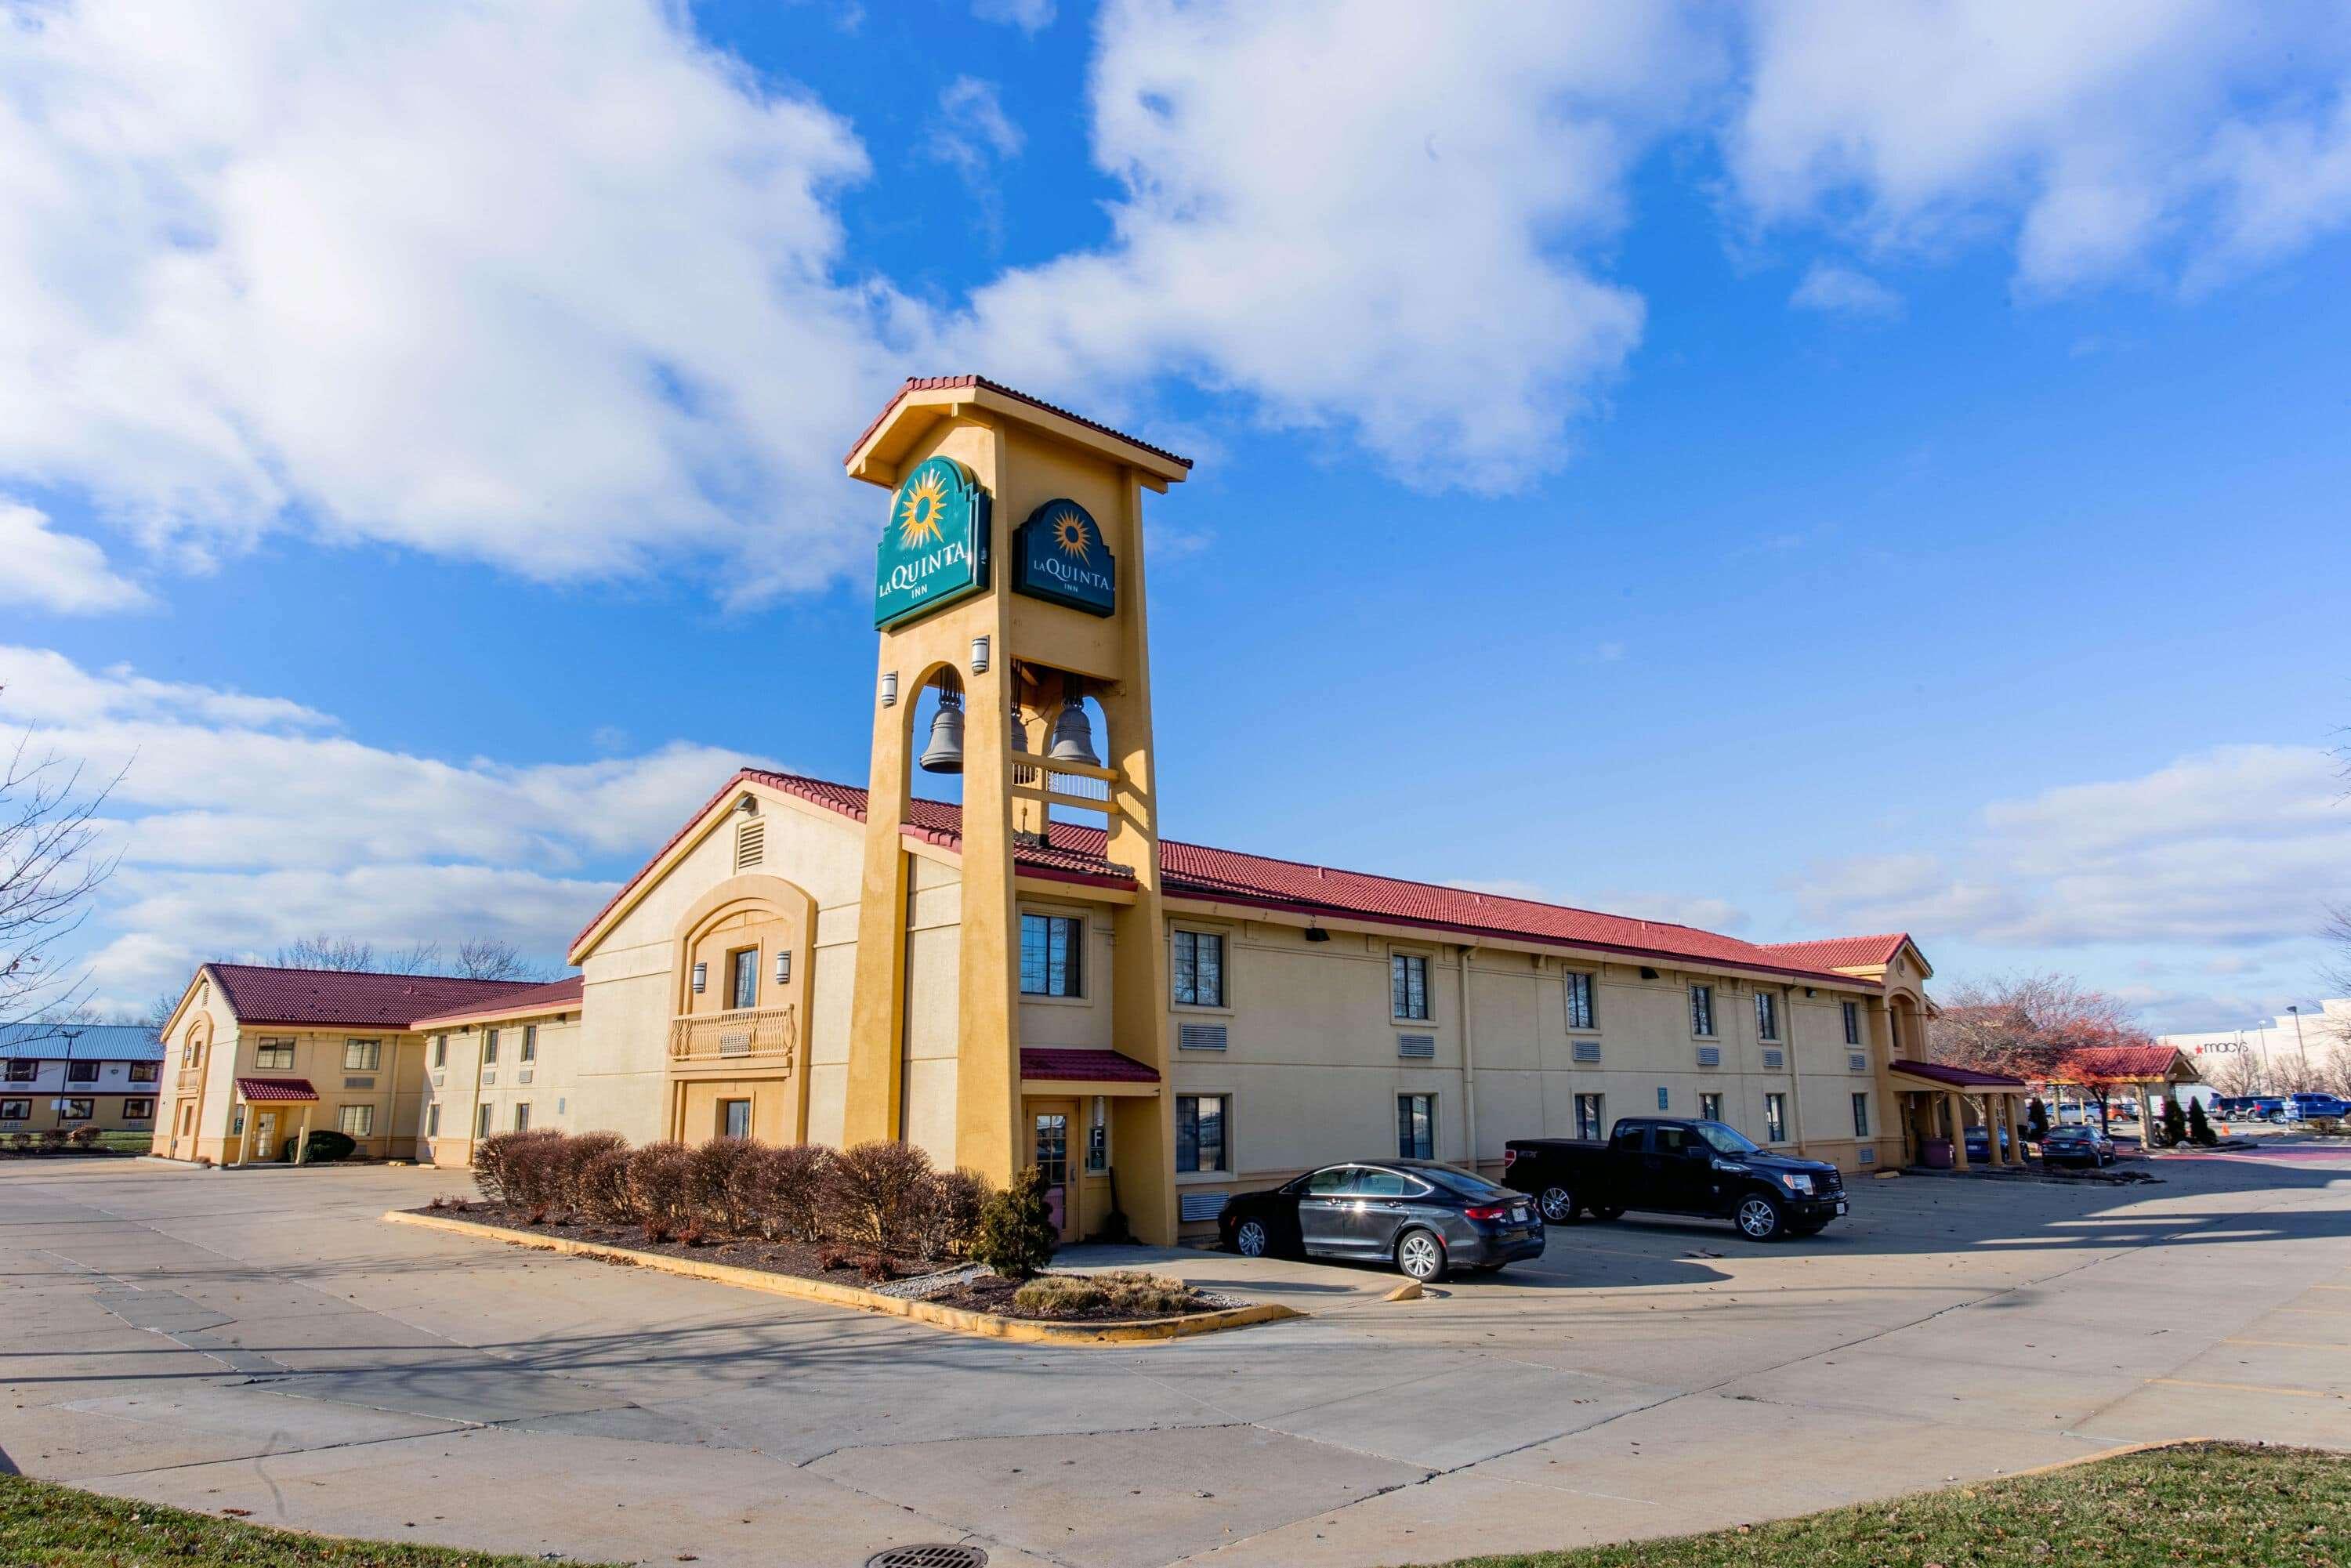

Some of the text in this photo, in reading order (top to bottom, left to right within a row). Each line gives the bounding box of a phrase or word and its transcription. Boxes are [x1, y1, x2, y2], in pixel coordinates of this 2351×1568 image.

[879, 541, 967, 598] LA QUINTA
[1034, 558, 1110, 590] LA QUINTA
[911, 584, 928, 599] INN
[1064, 583, 1079, 593] INN
[1094, 1129, 1102, 1147] F
